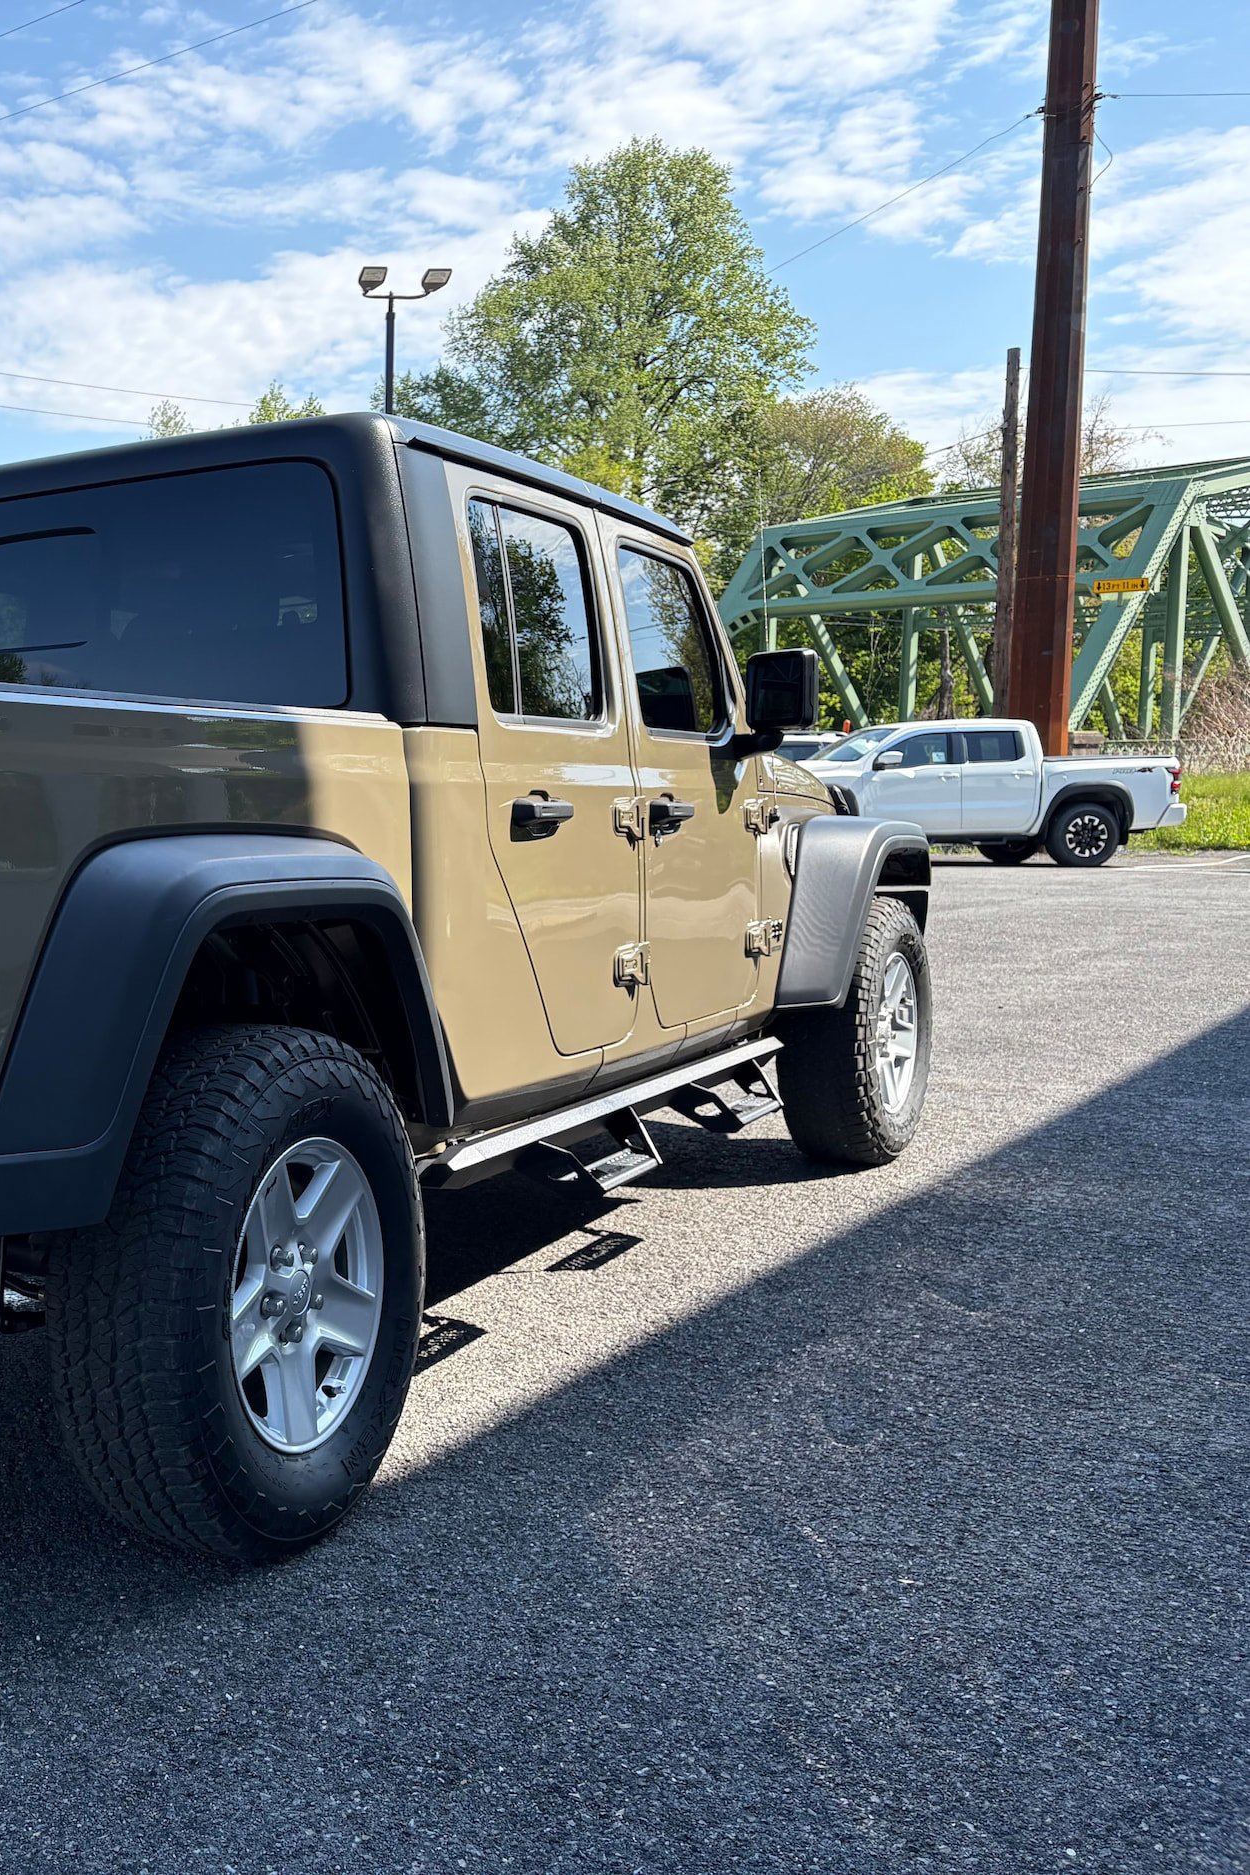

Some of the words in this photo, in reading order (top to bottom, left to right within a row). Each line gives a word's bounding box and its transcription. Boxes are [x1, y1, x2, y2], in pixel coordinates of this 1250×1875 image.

[1102, 582, 1111, 591] 13
[1111, 582, 1120, 590] FT
[1122, 581, 1130, 590] 11
[1131, 582, 1139, 590] IN
